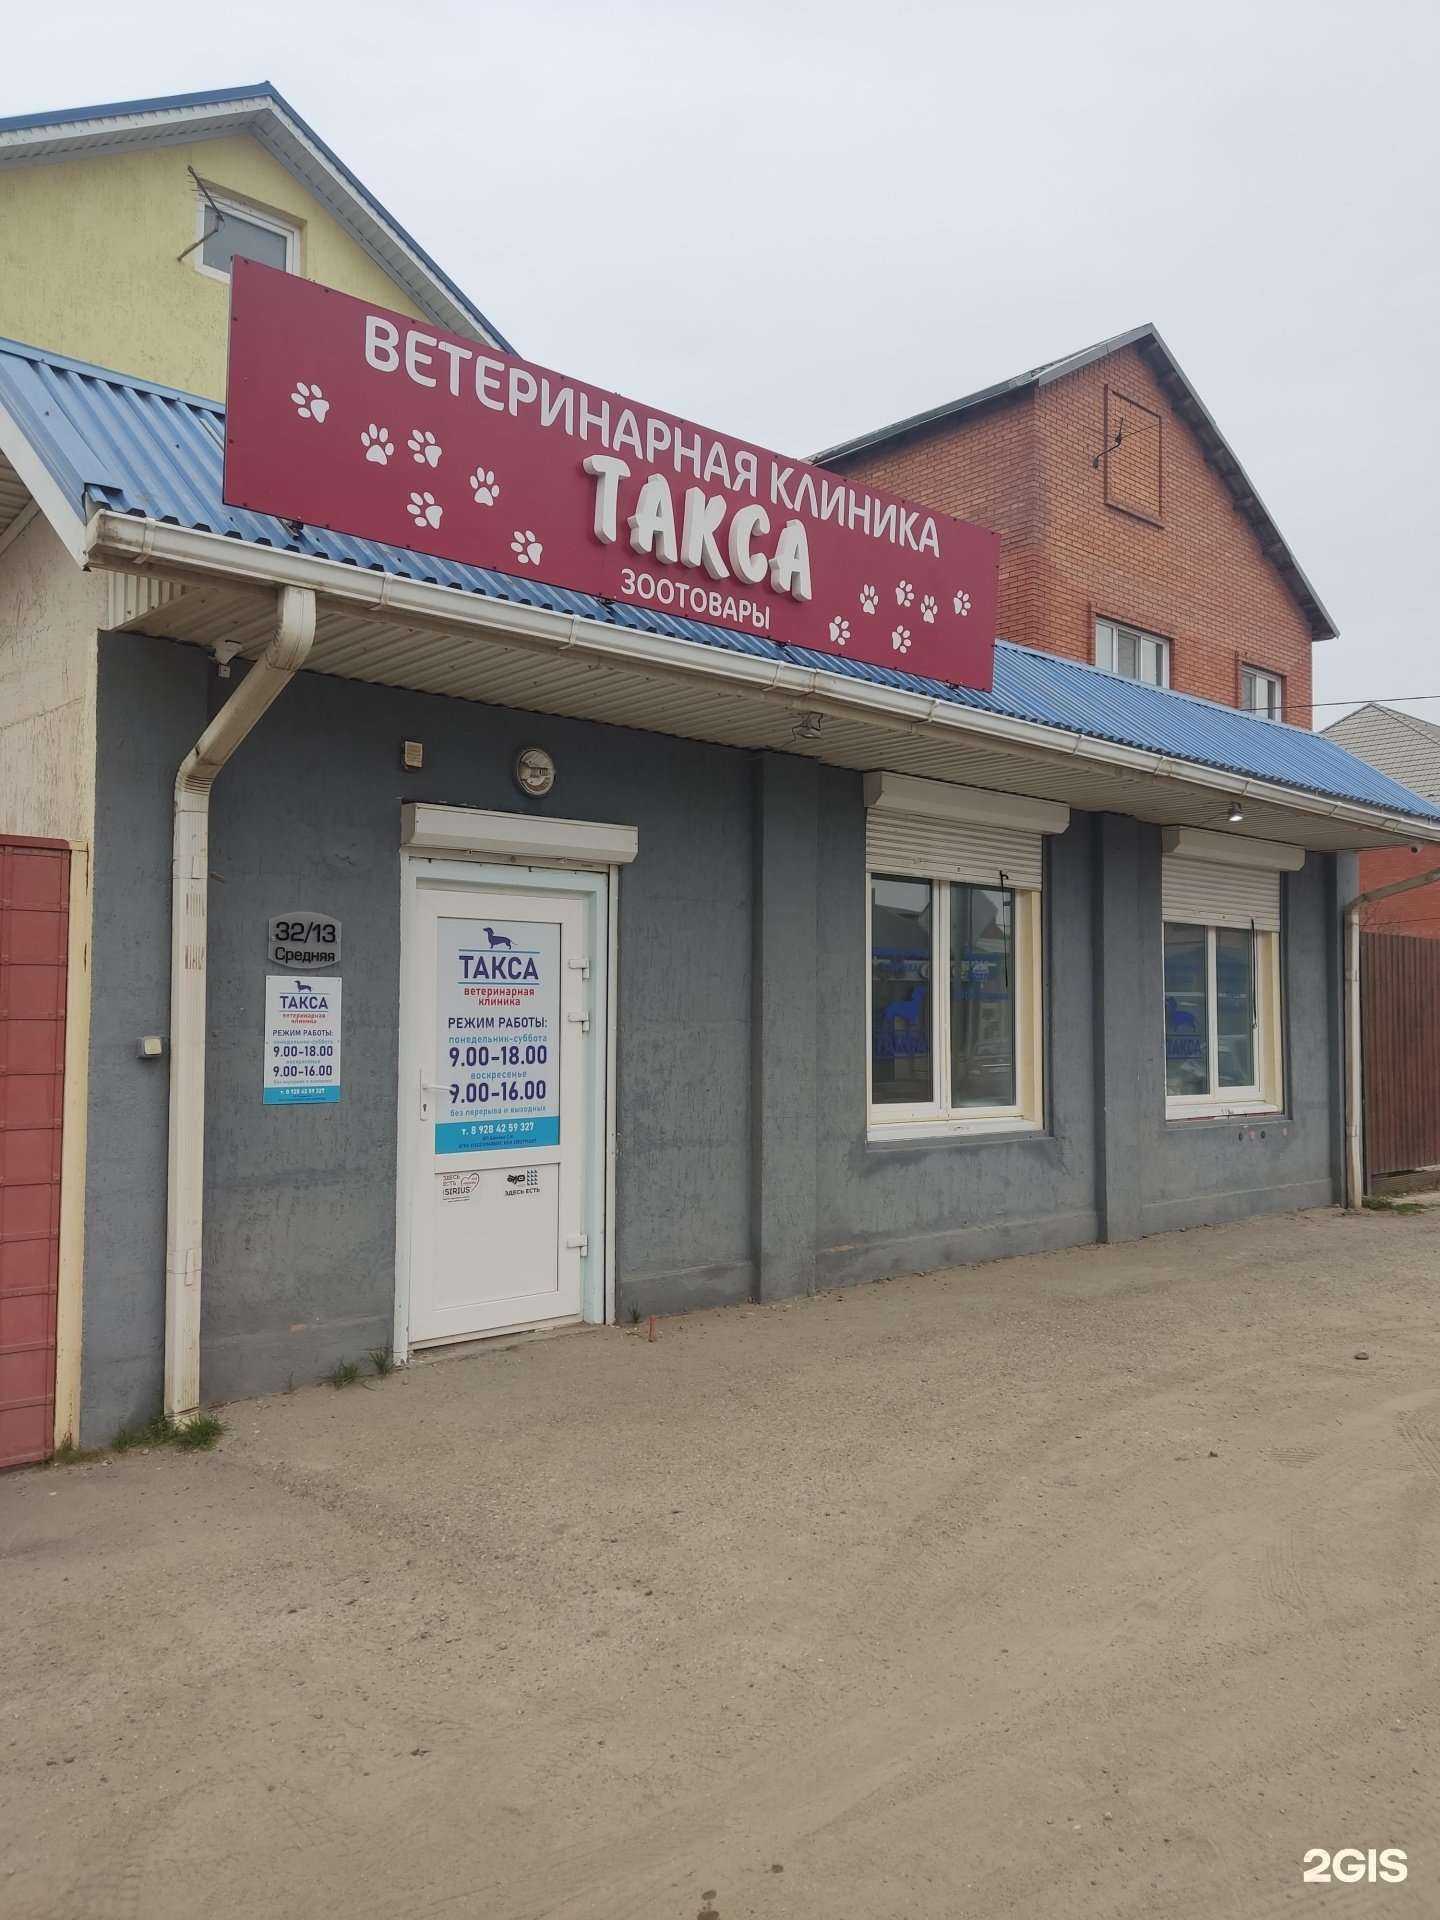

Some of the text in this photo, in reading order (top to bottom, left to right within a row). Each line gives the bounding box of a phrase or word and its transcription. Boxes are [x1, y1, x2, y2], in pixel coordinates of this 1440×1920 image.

[364, 314, 939, 558] ВЕТЕРИНАРНАЯ КЛИНИКА
[582, 454, 812, 602] ТАКСА
[620, 568, 770, 629] ЗООТОВАРЫ
[275, 921, 336, 943] 32/13
[275, 947, 335, 964] Средняя
[459, 955, 539, 980] ТАКСА
[464, 987, 535, 998] ветеринарная
[280, 995, 329, 1010] ТАКСА
[478, 998, 521, 1006] клиника
[448, 1016, 548, 1029] РЕЖИМ РАБОТЫ:
[272, 1029, 334, 1037] РЕЖИМ РАБОТЫ:
[273, 1046, 333, 1058] 9.00-18.00
[449, 1045, 548, 1067] 9.00-18.00
[273, 1065, 333, 1078] 9.00-16.00
[449, 1080, 546, 1104] 9.00-16.00
[470, 1126, 477, 1135] 8
[478, 1125, 494, 1134] 928
[508, 1122, 518, 1132] 59
[520, 1121, 534, 1132] 327
[444, 1186, 472, 1196] SIRIUS
